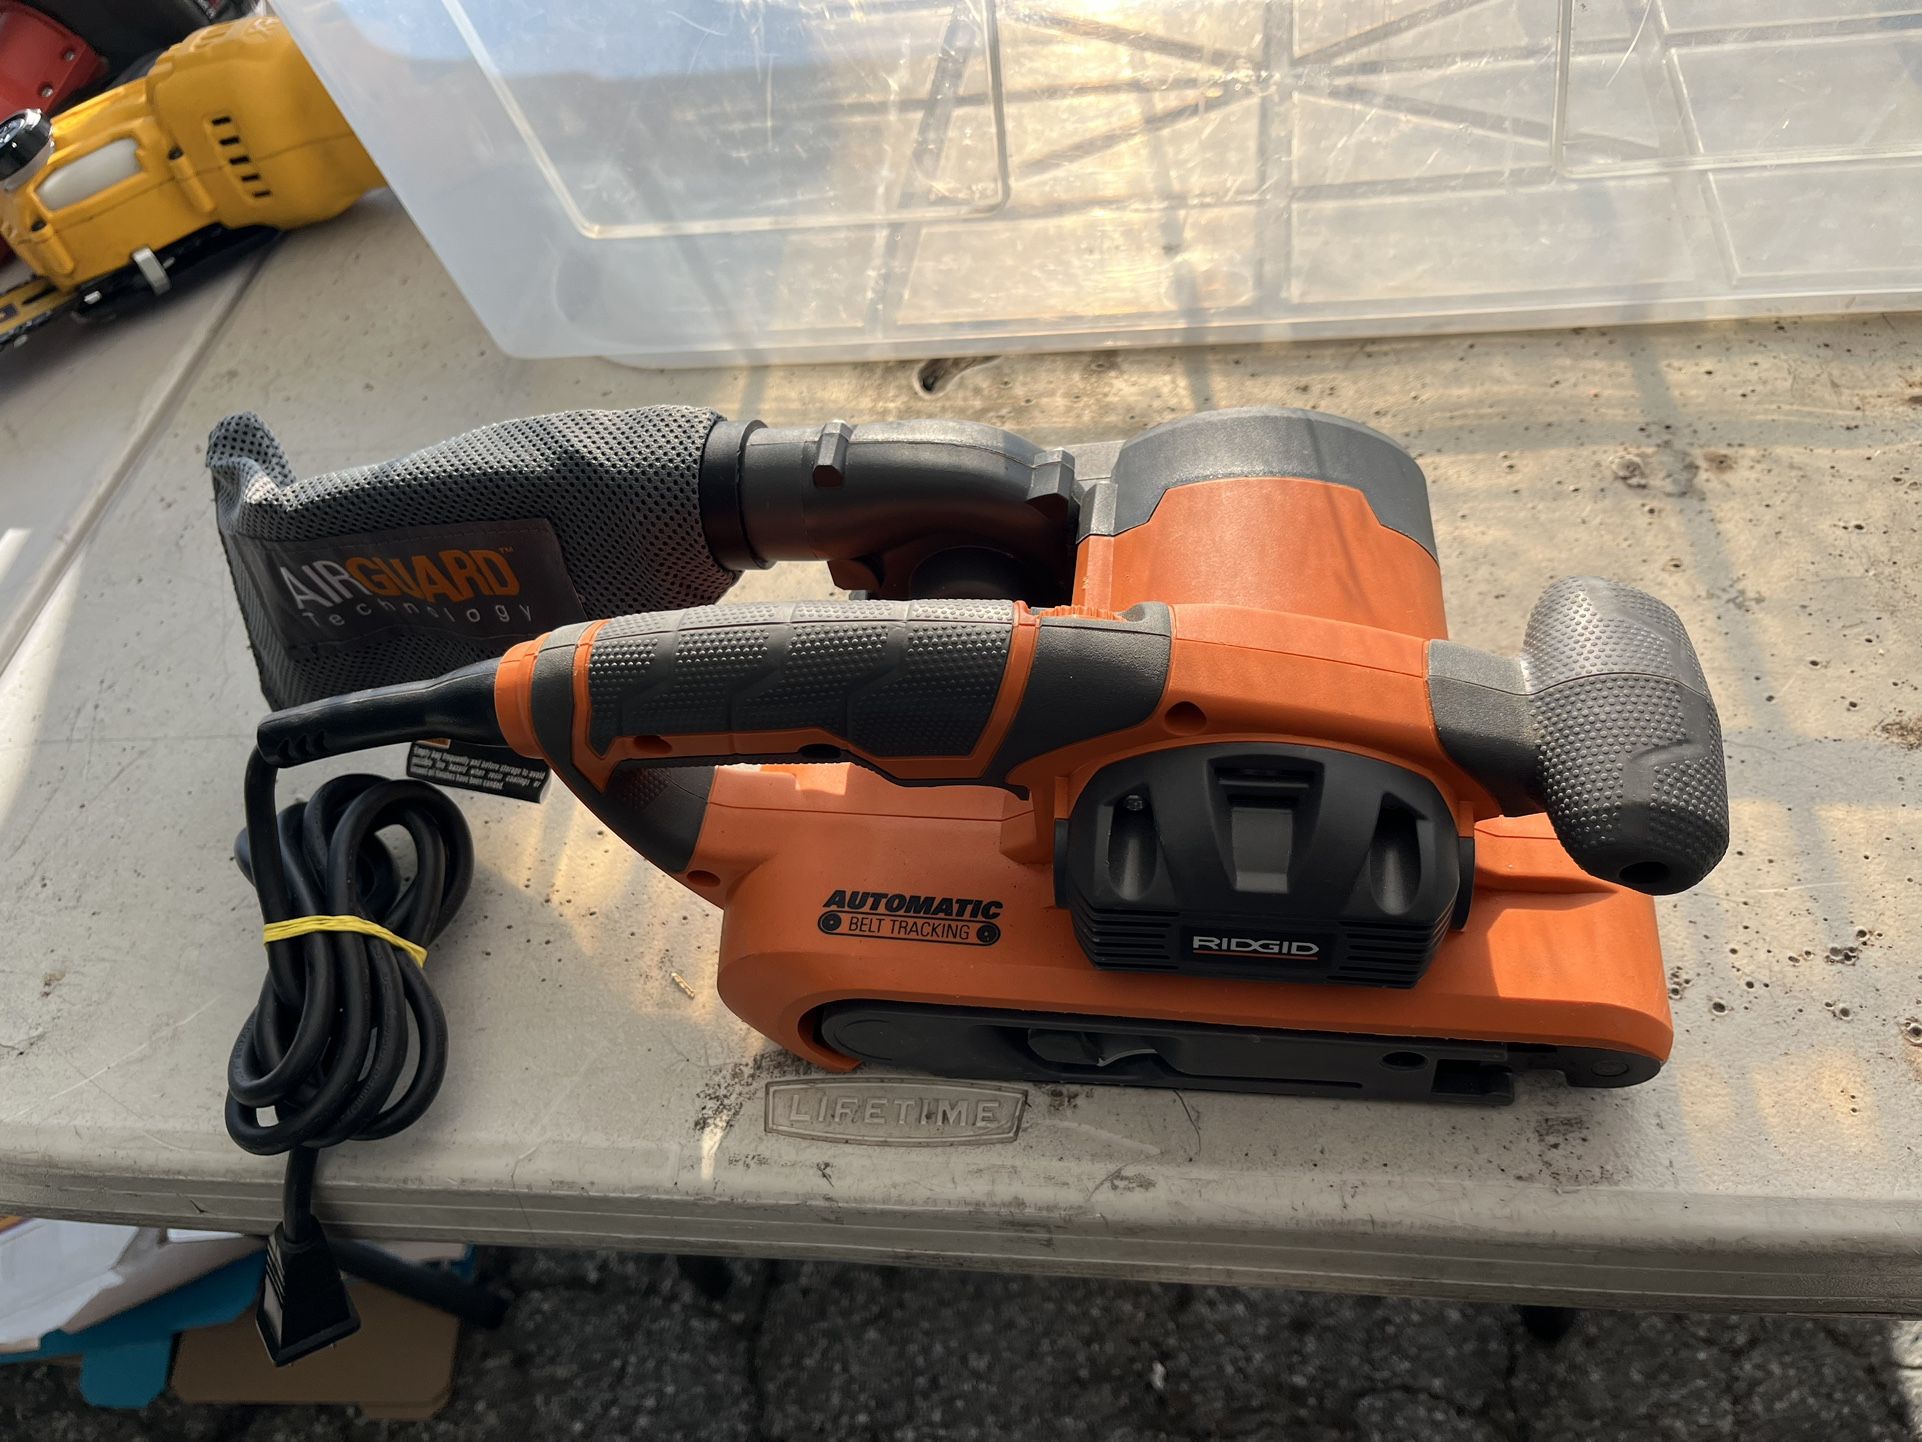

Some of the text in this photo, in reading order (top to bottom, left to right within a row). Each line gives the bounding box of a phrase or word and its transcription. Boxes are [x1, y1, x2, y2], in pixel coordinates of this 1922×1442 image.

[481, 760, 500, 770] before
[500, 764, 521, 776] storage
[529, 770, 546, 780] avoid
[823, 890, 1003, 920] AUTOMATIC
[848, 916, 970, 940] BELT TRACKING
[1193, 935, 1320, 955] RIDGID
[789, 1094, 1000, 1127] LIFETIME
